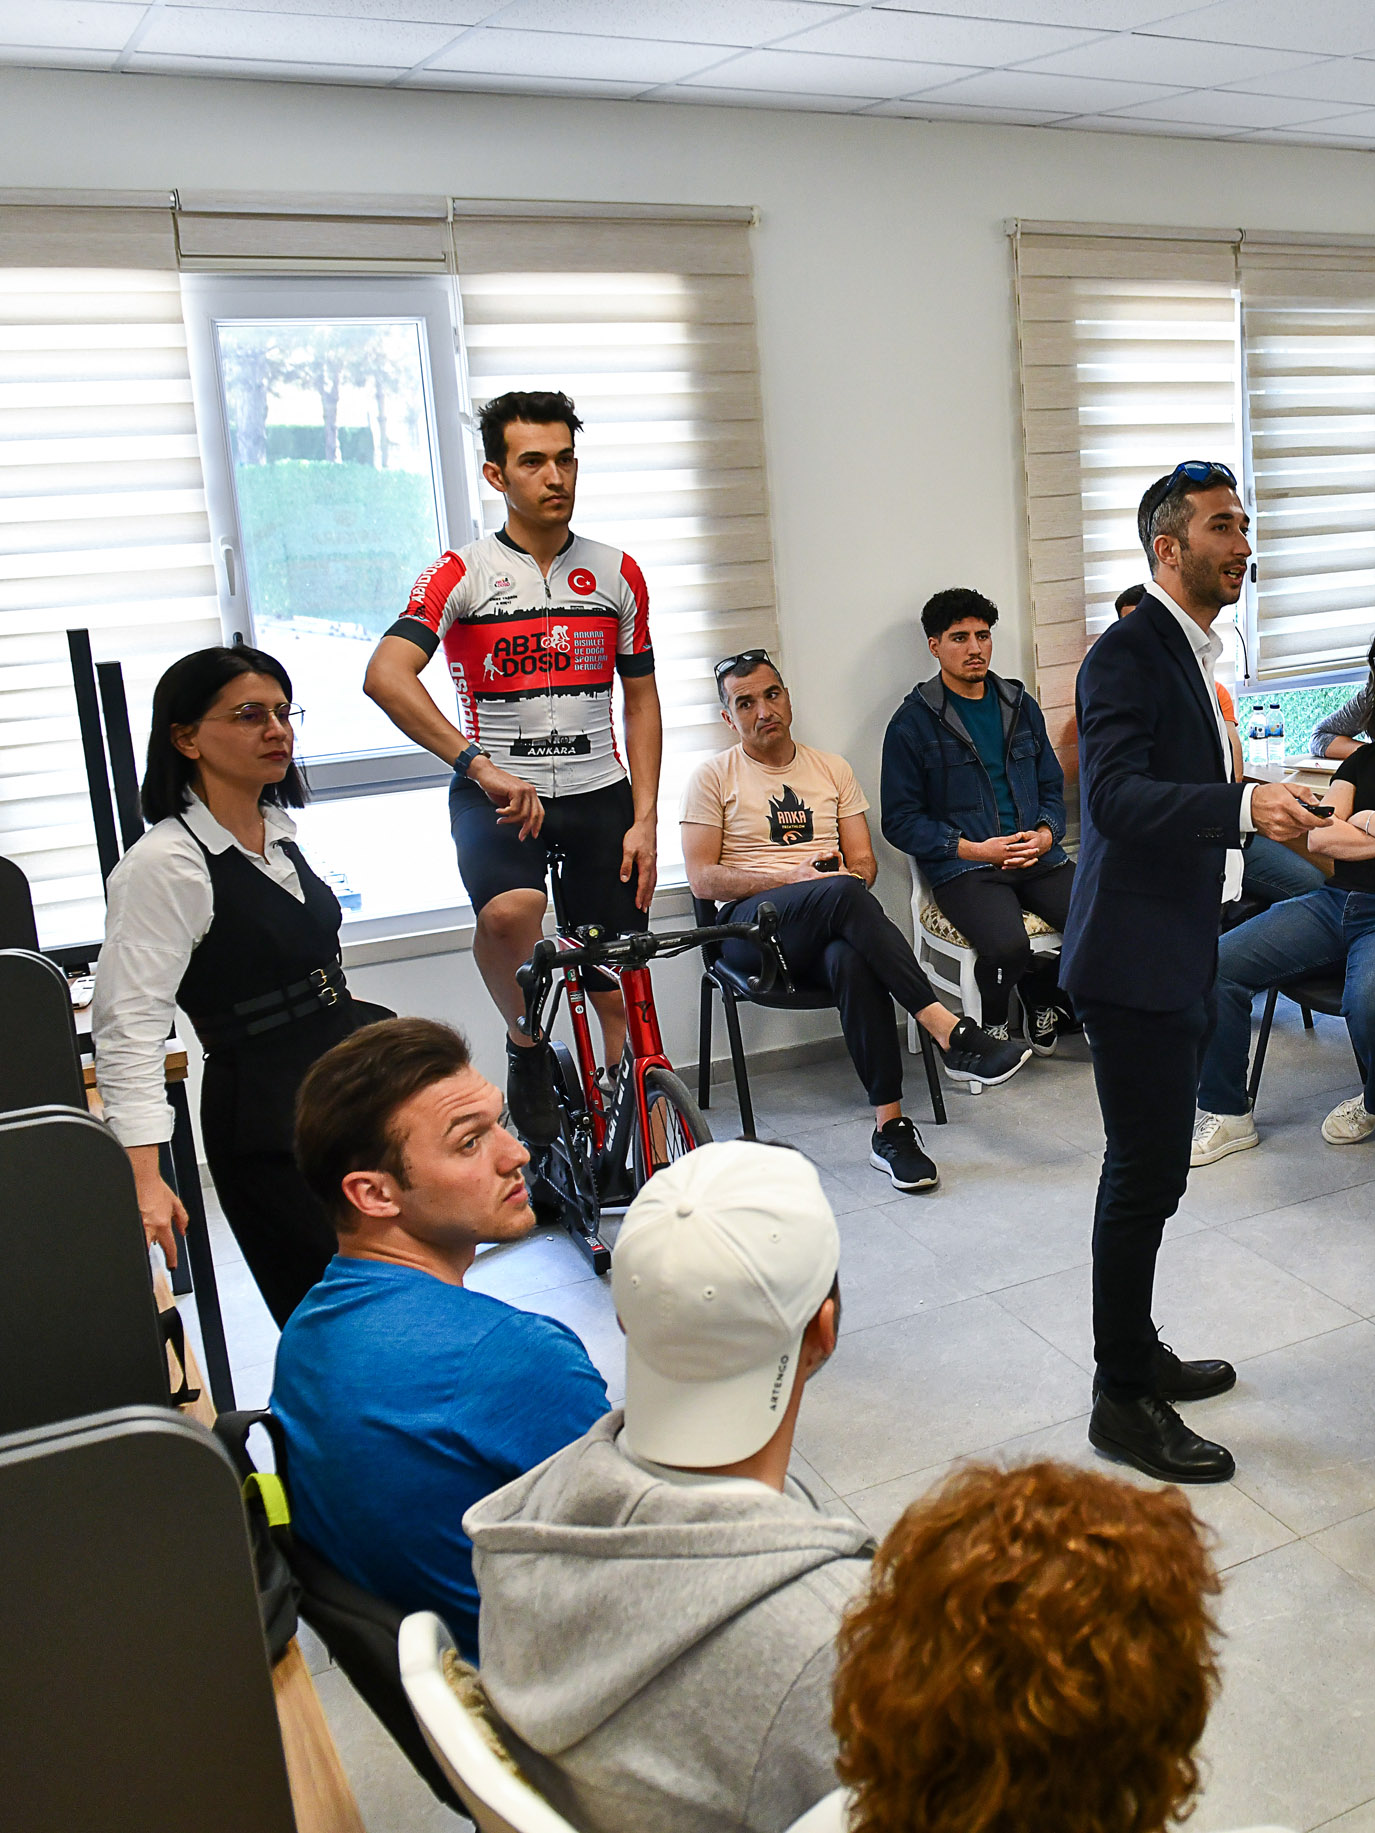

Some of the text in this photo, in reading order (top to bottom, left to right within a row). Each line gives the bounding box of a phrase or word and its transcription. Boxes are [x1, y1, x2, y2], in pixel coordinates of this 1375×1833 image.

[573, 631, 604, 639] ANKARA
[494, 632, 546, 658] ABI
[502, 651, 571, 677] DOSD
[527, 746, 576, 756] ANKARA
[777, 811, 807, 824] ANKA
[769, 1354, 789, 1411] ARTENGO
